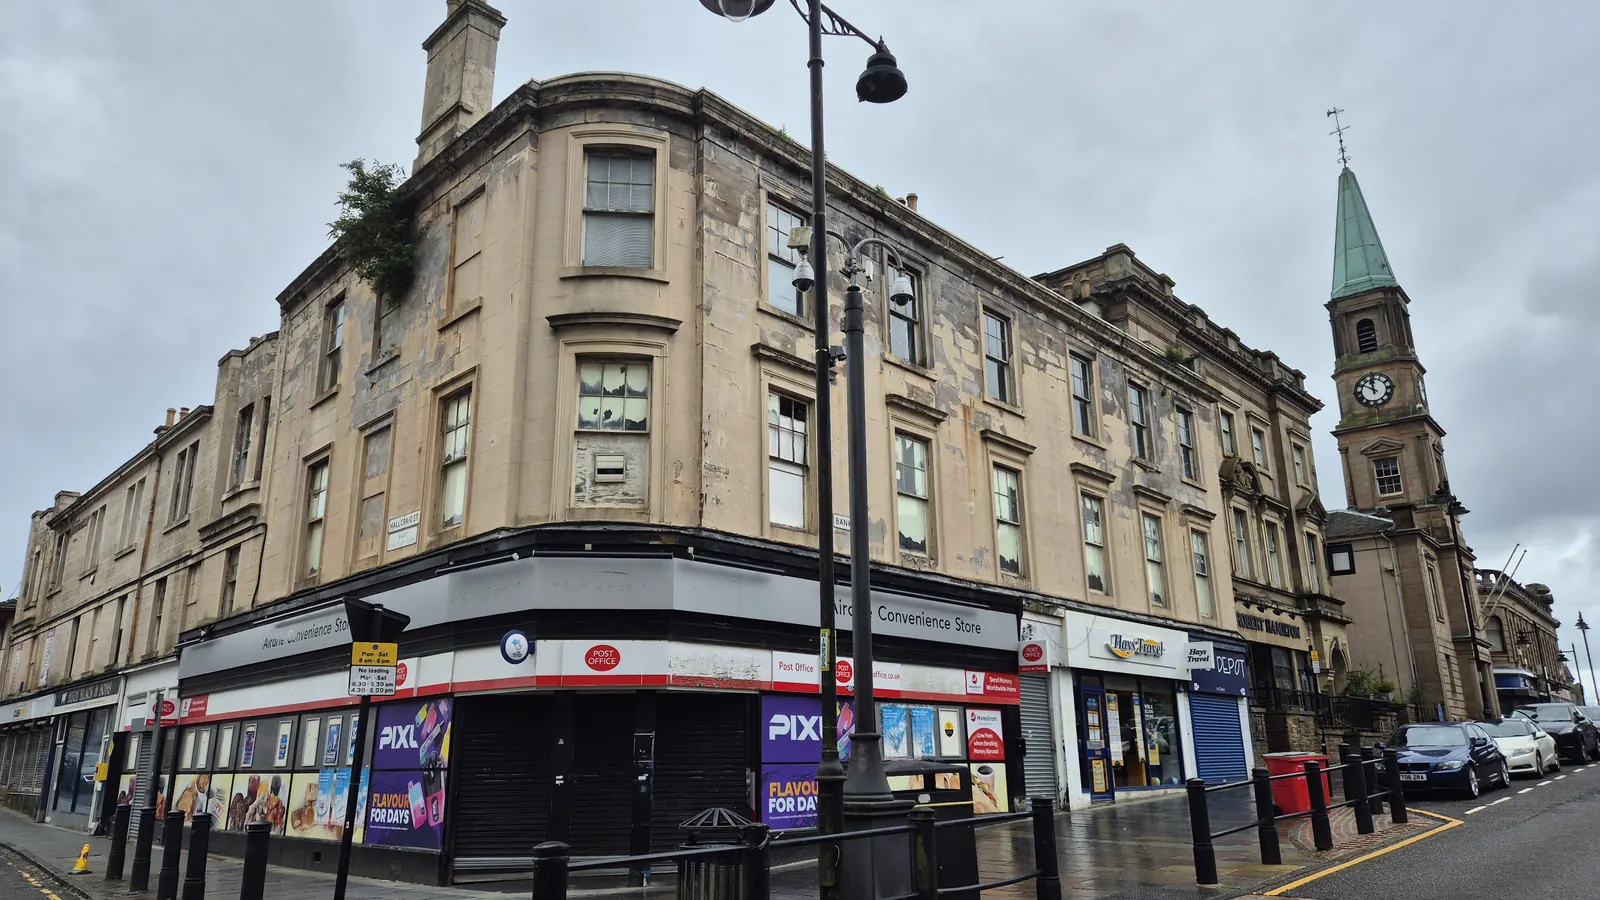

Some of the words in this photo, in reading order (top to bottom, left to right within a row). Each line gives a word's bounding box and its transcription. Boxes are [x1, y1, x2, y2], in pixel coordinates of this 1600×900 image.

[878, 605, 951, 630] Convenience
[955, 617, 981, 634] Store
[1235, 611, 1264, 631] ROBERT
[1265, 619, 1300, 639] HAMILTON
[1112, 634, 1136, 653] Hays
[1137, 638, 1164, 656] Travel
[588, 657, 616, 665] OFFICE
[778, 661, 793, 671] Post
[795, 662, 814, 673] Office
[1216, 656, 1246, 678] DEPOT
[379, 724, 418, 750] PIXL
[372, 793, 409, 808] FLAVOUR
[769, 797, 795, 813] FOR
[370, 808, 387, 823] FOR
[387, 809, 409, 824] DAYS
